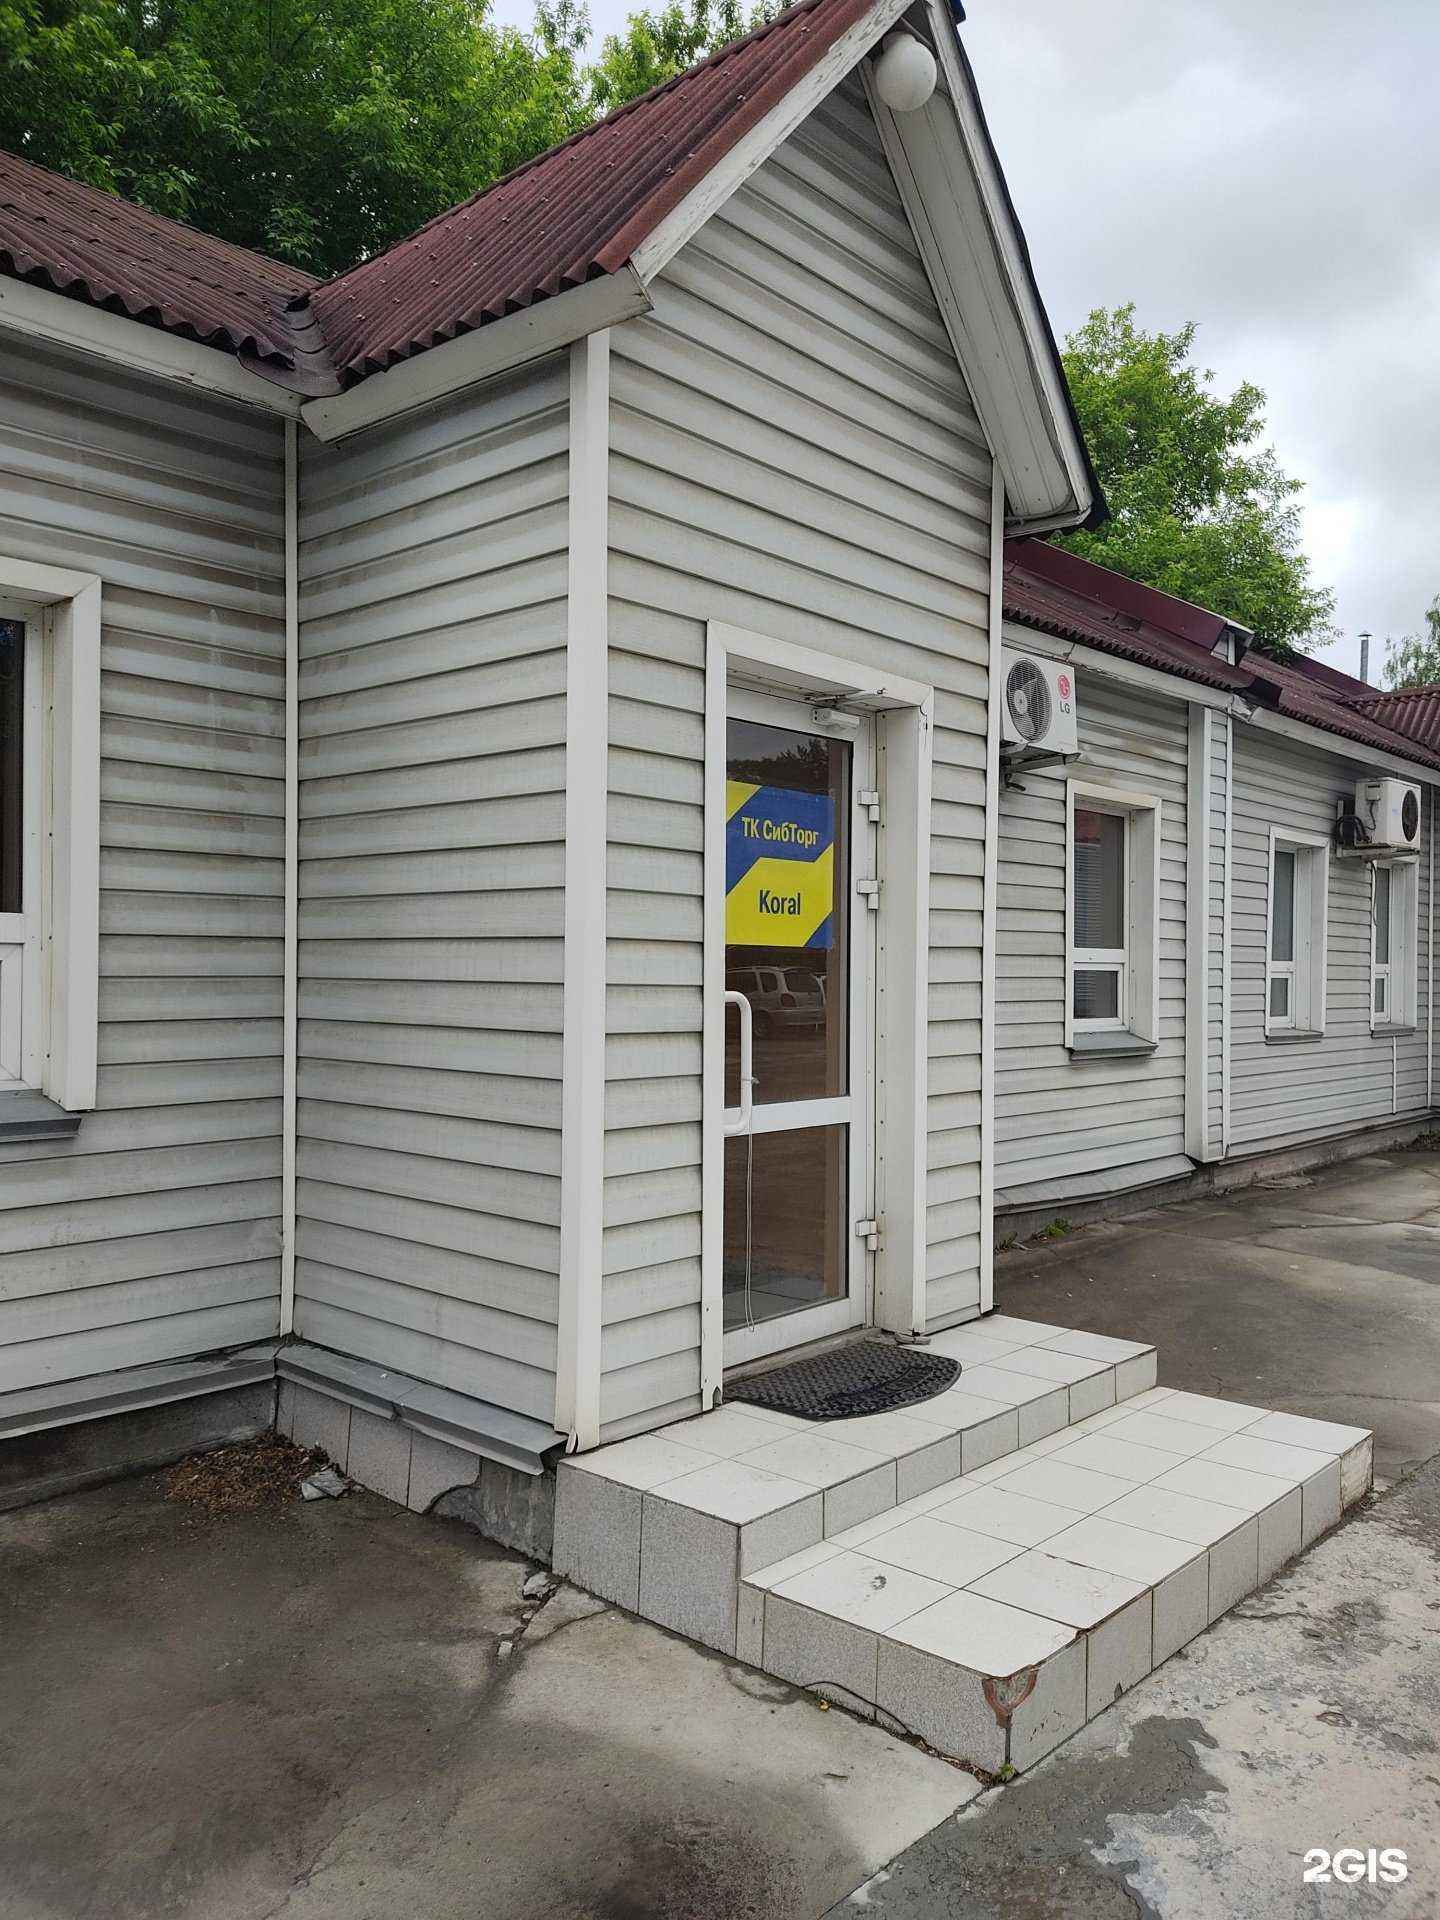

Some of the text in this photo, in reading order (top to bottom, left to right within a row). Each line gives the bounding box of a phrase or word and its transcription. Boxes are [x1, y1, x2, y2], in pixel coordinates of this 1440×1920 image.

[1059, 701, 1071, 714] LG
[742, 817, 821, 849] ТК СибТорг
[759, 889, 801, 915] Koral
